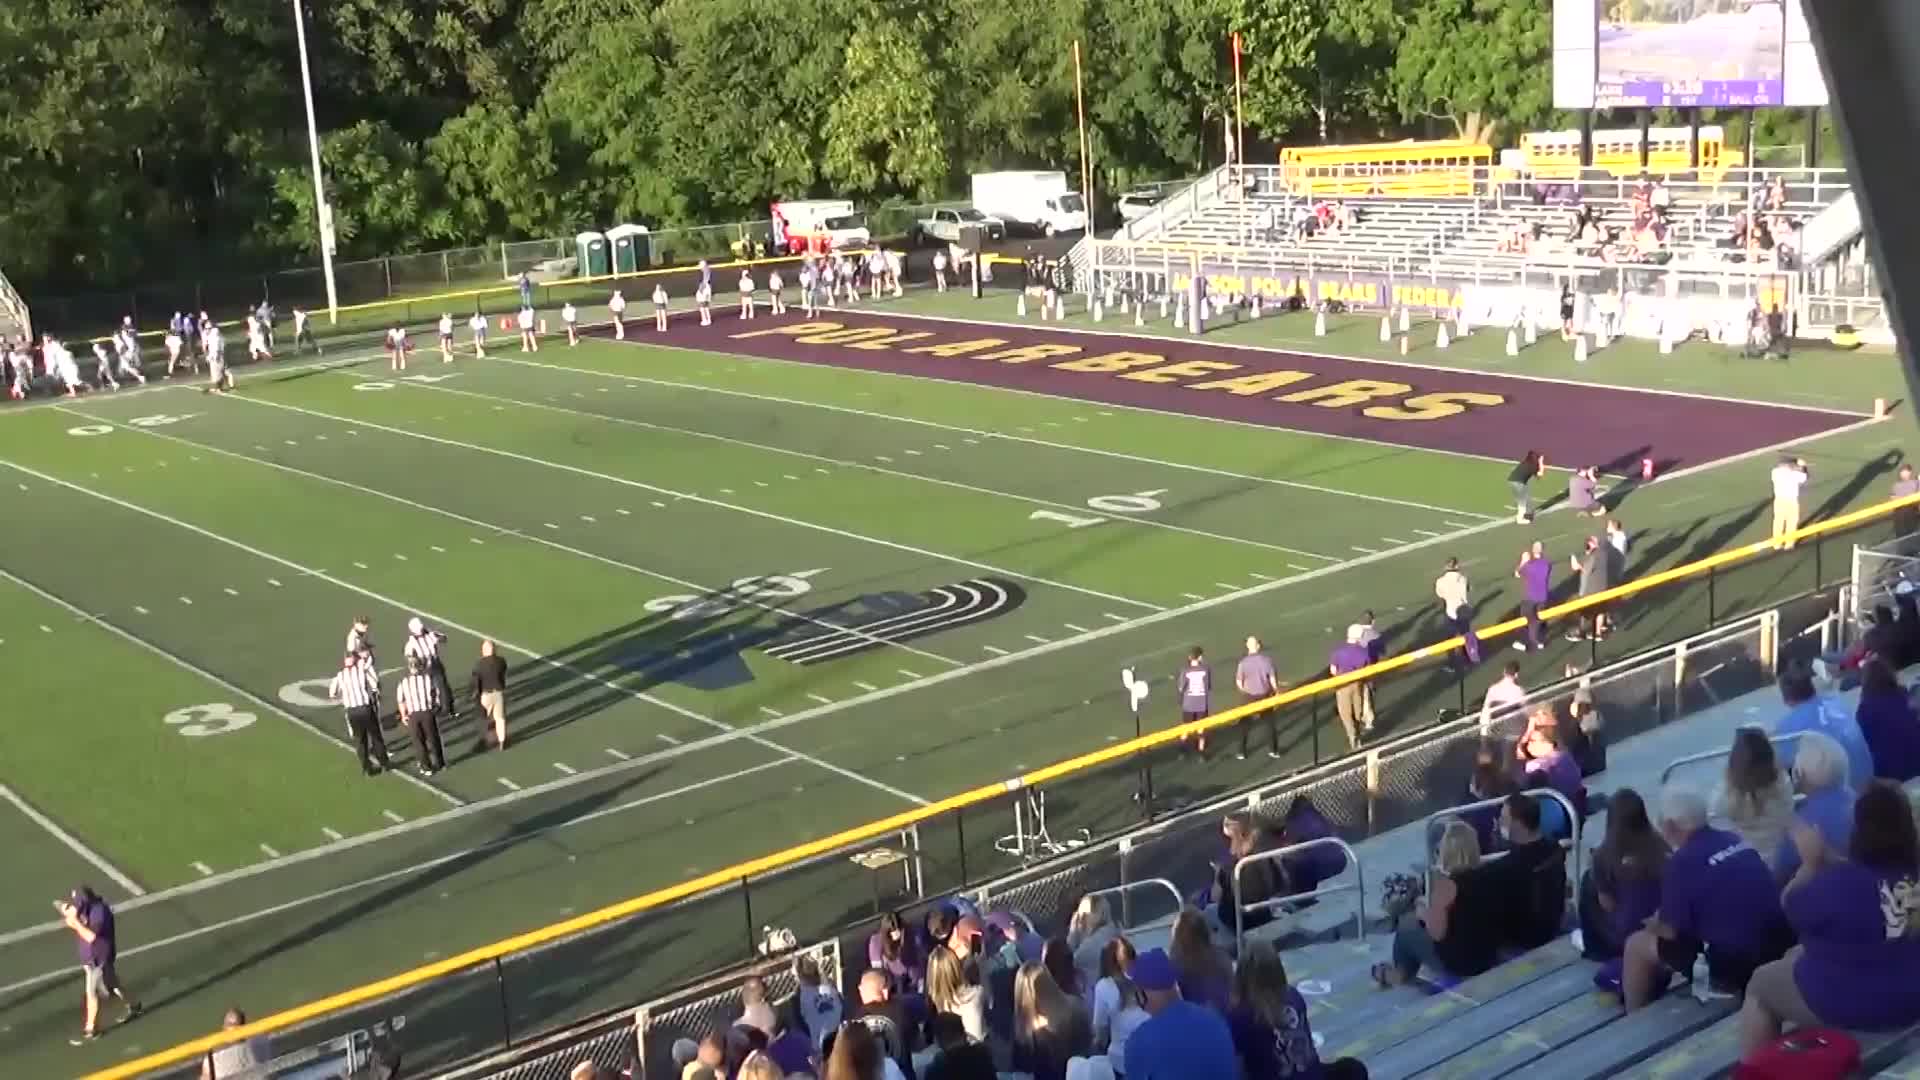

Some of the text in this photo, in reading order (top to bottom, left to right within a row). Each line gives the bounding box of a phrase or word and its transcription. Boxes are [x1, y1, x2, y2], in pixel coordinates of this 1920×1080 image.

[1172, 271, 1244, 295] JASON
[1318, 280, 1377, 301] BEARS
[1392, 286, 1465, 308] FEDERA
[728, 321, 1505, 420] POLAR BEARS
[1028, 495, 1161, 528] 10
